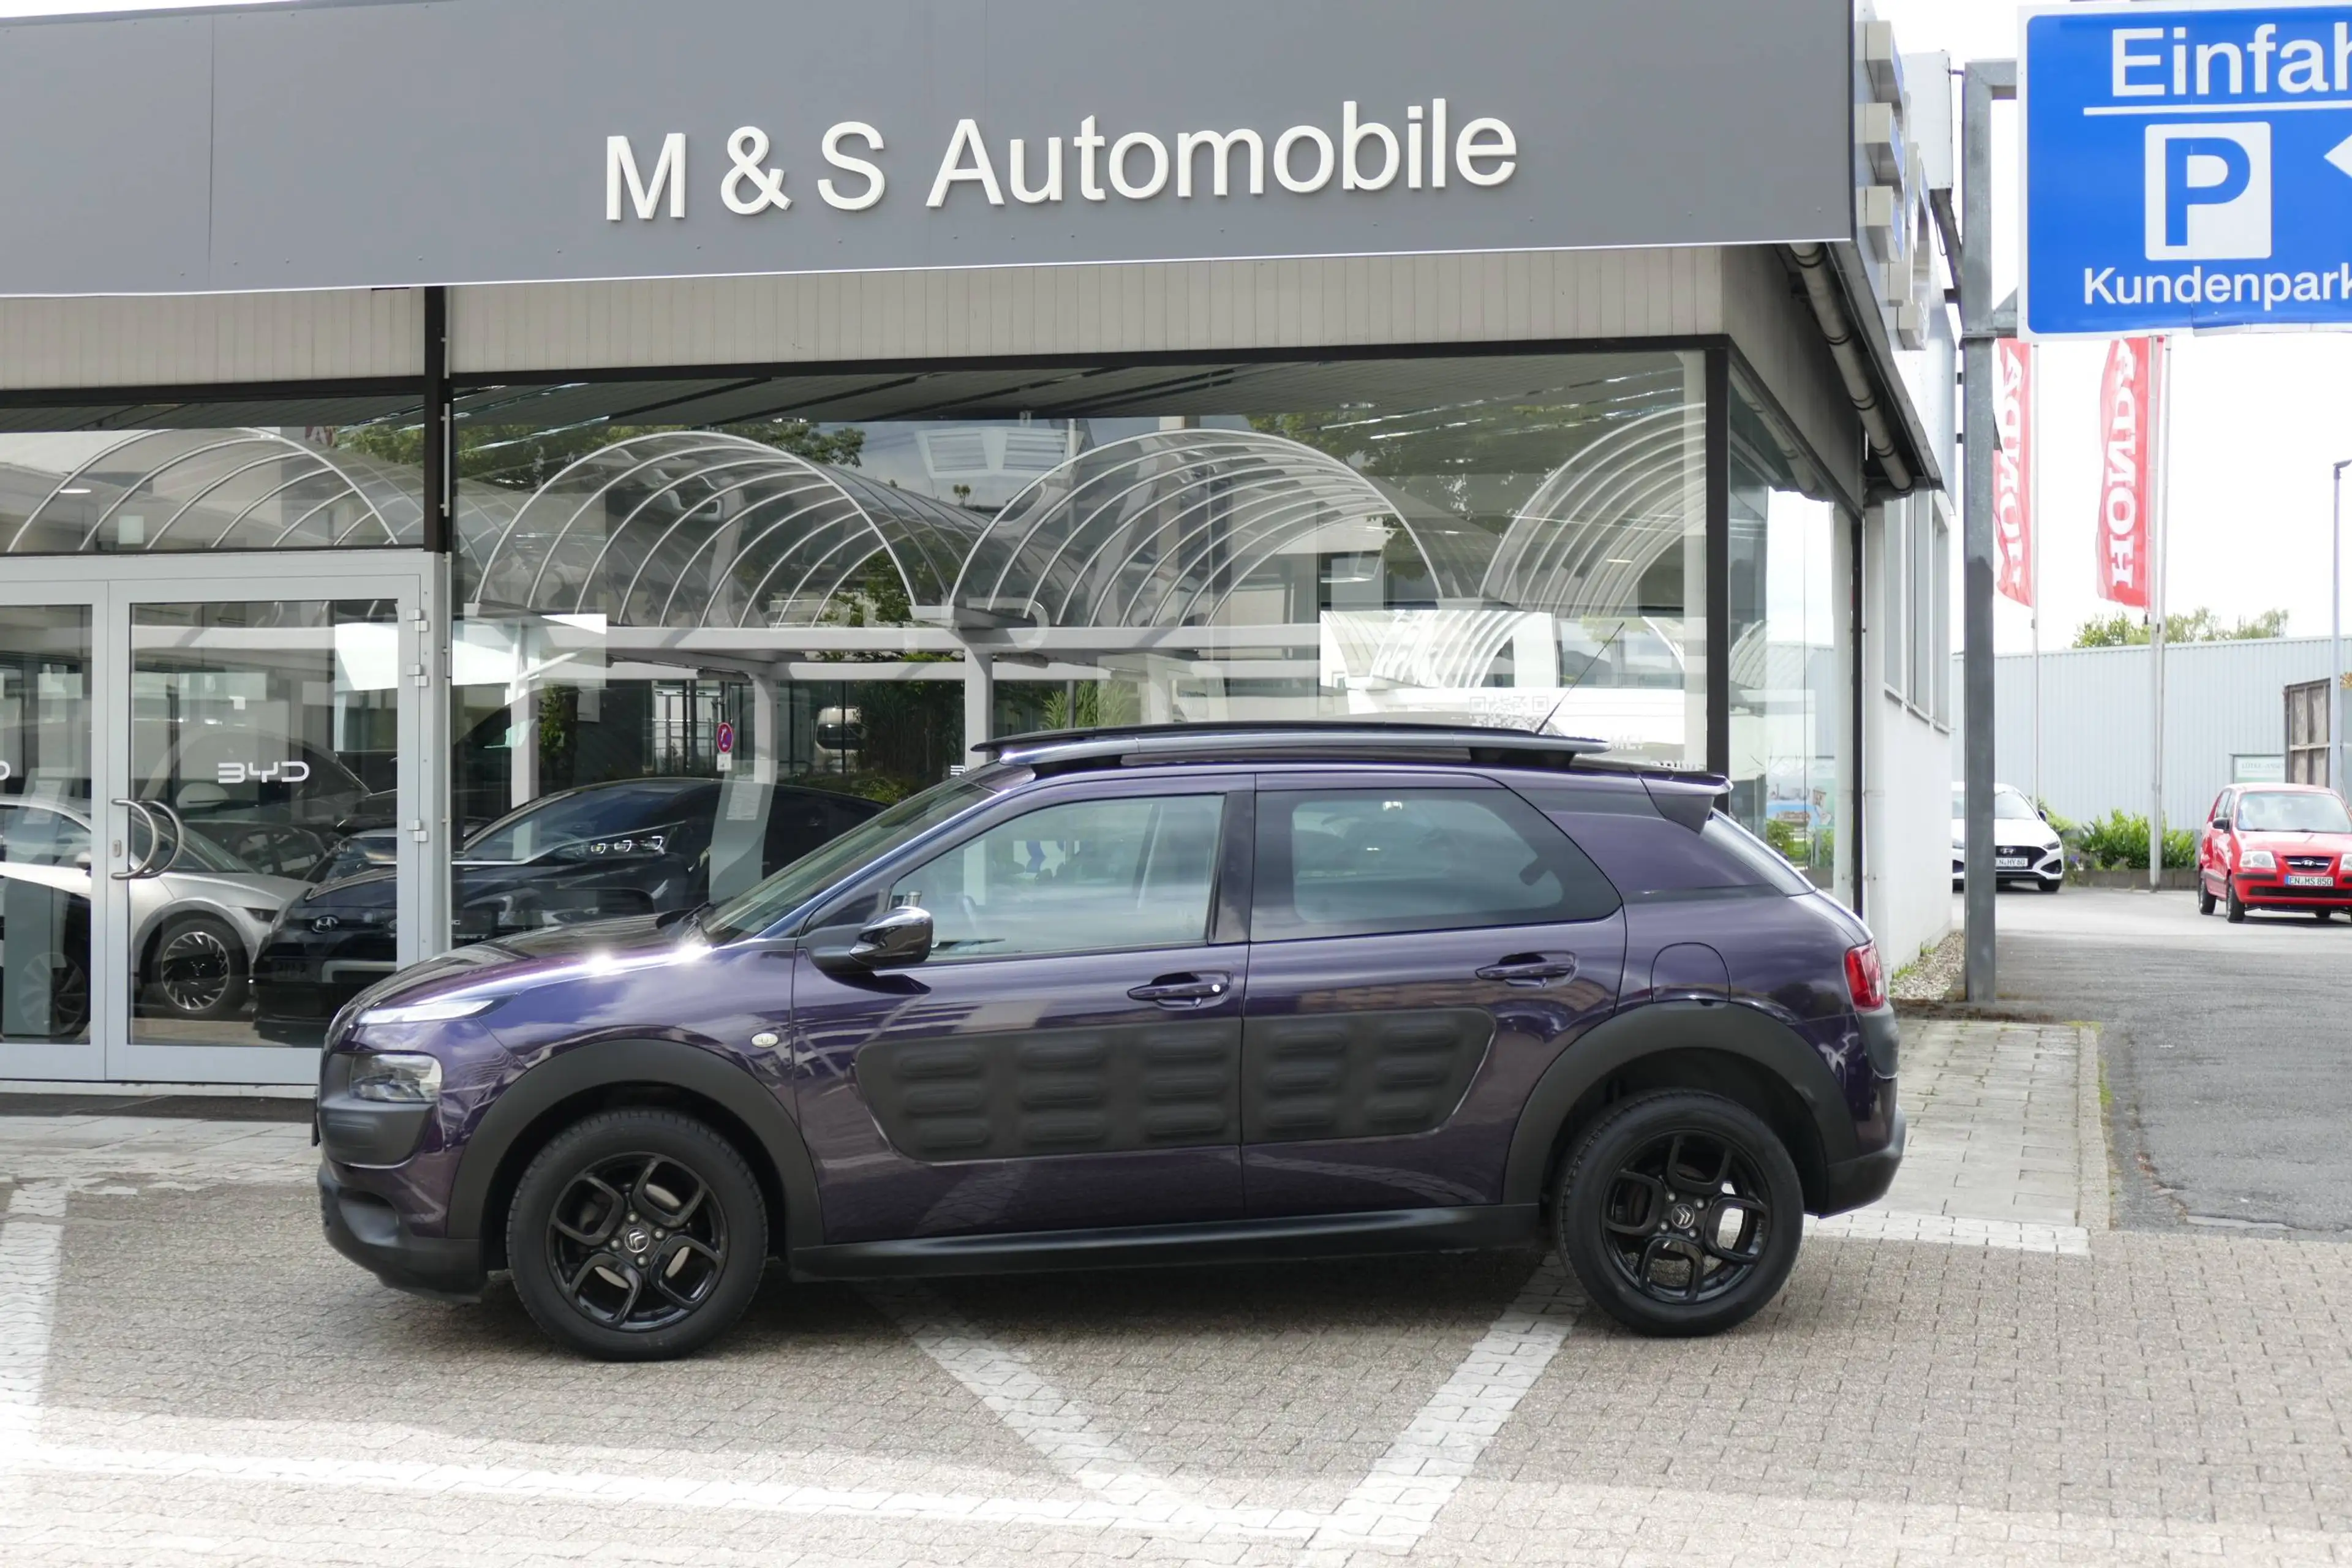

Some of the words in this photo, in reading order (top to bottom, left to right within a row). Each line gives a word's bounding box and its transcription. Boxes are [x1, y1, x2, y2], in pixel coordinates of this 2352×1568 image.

[606, 132, 686, 221] M
[721, 126, 792, 216] &
[818, 121, 885, 210] S
[925, 98, 1517, 208] Automobile
[2165, 137, 2251, 247] P
[217, 761, 310, 784] BYD
[2304, 876, 2315, 885] MS
